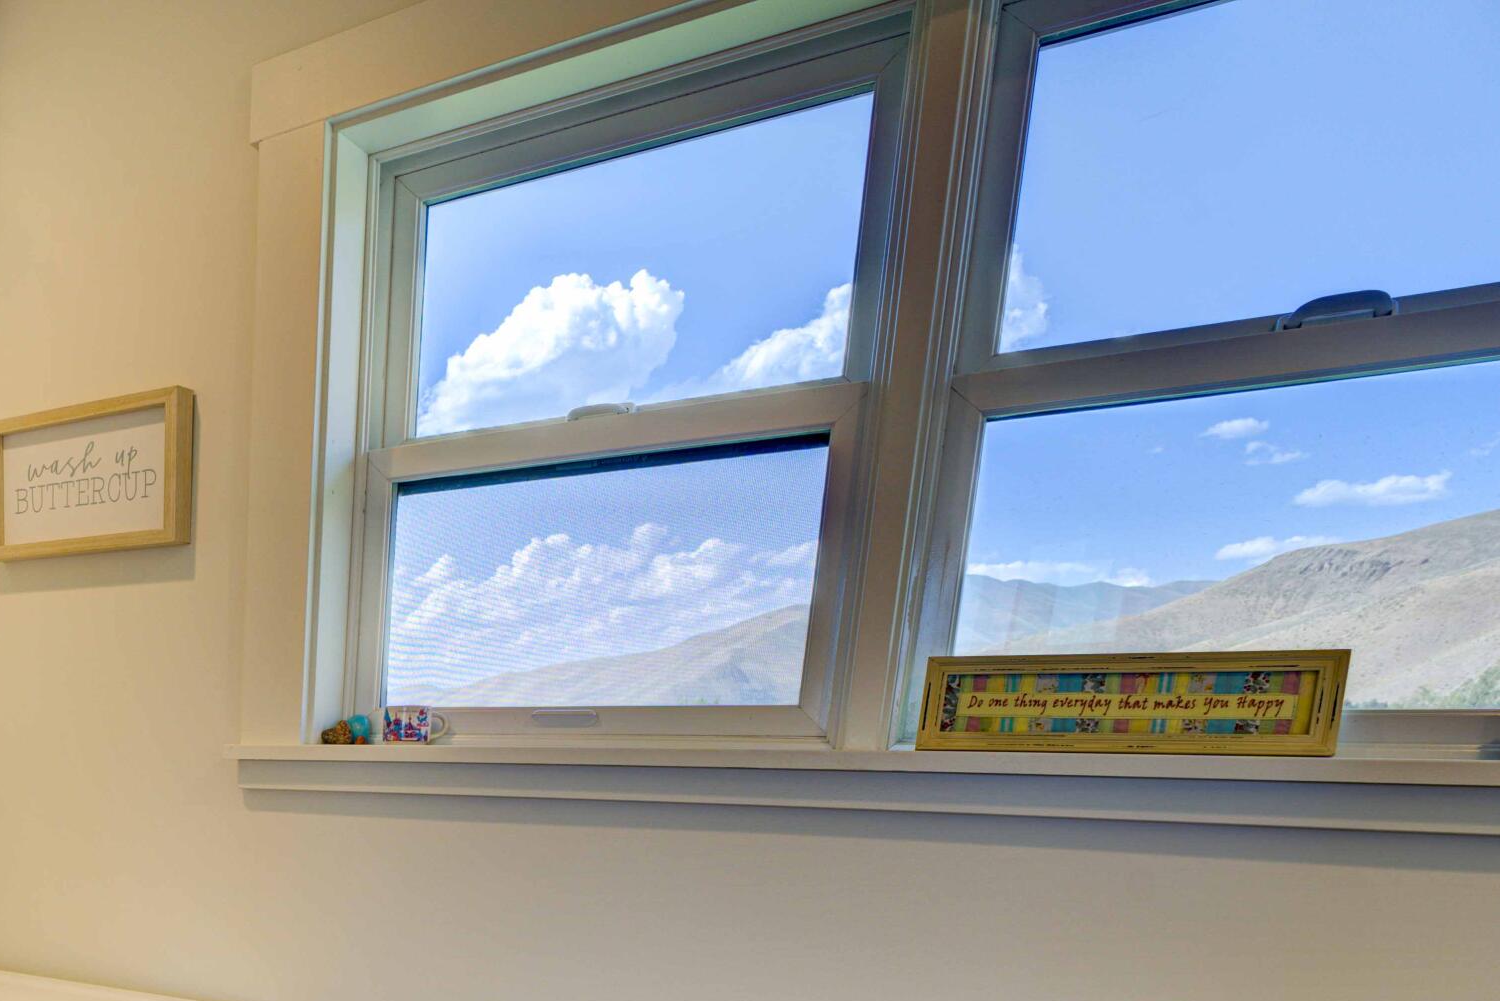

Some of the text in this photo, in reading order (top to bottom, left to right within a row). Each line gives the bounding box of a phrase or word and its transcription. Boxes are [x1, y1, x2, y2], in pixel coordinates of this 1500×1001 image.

[27, 441, 138, 482] wash up
[14, 468, 157, 515] BUTTERCUP
[967, 695, 983, 708] Do
[988, 697, 1009, 708] one
[1014, 693, 1047, 715] thing
[1052, 695, 1111, 716] everyday
[1118, 695, 1148, 710] that
[1153, 696, 1197, 710] makes
[1236, 696, 1285, 717] Happy
